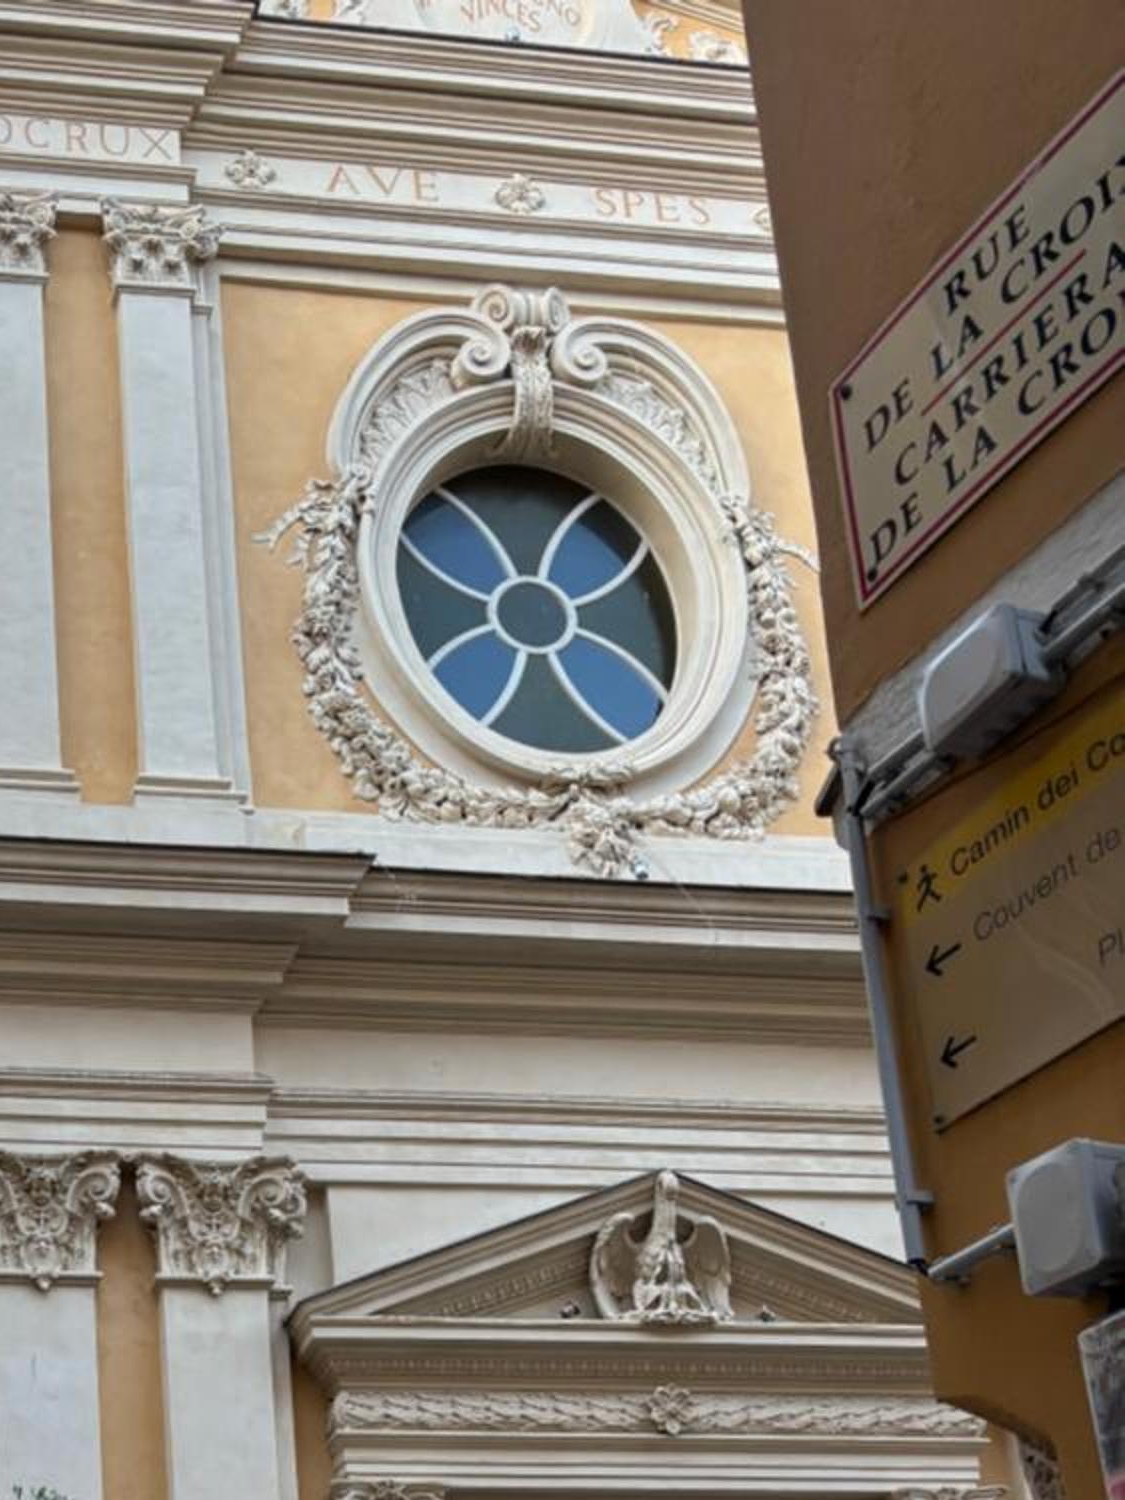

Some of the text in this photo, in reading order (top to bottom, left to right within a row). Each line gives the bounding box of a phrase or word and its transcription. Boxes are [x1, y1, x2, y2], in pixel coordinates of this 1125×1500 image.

[326, 164, 440, 203] AVE
[593, 187, 712, 226] SPES
[864, 154, 1125, 452] DE LA CROI
[943, 204, 1030, 317] RUE
[894, 240, 1125, 486] CARRIERA
[870, 286, 1125, 566] DE LA CRO
[949, 804, 1031, 877] Camin
[1037, 760, 1081, 812] dei
[973, 827, 1123, 942] Couvent de
